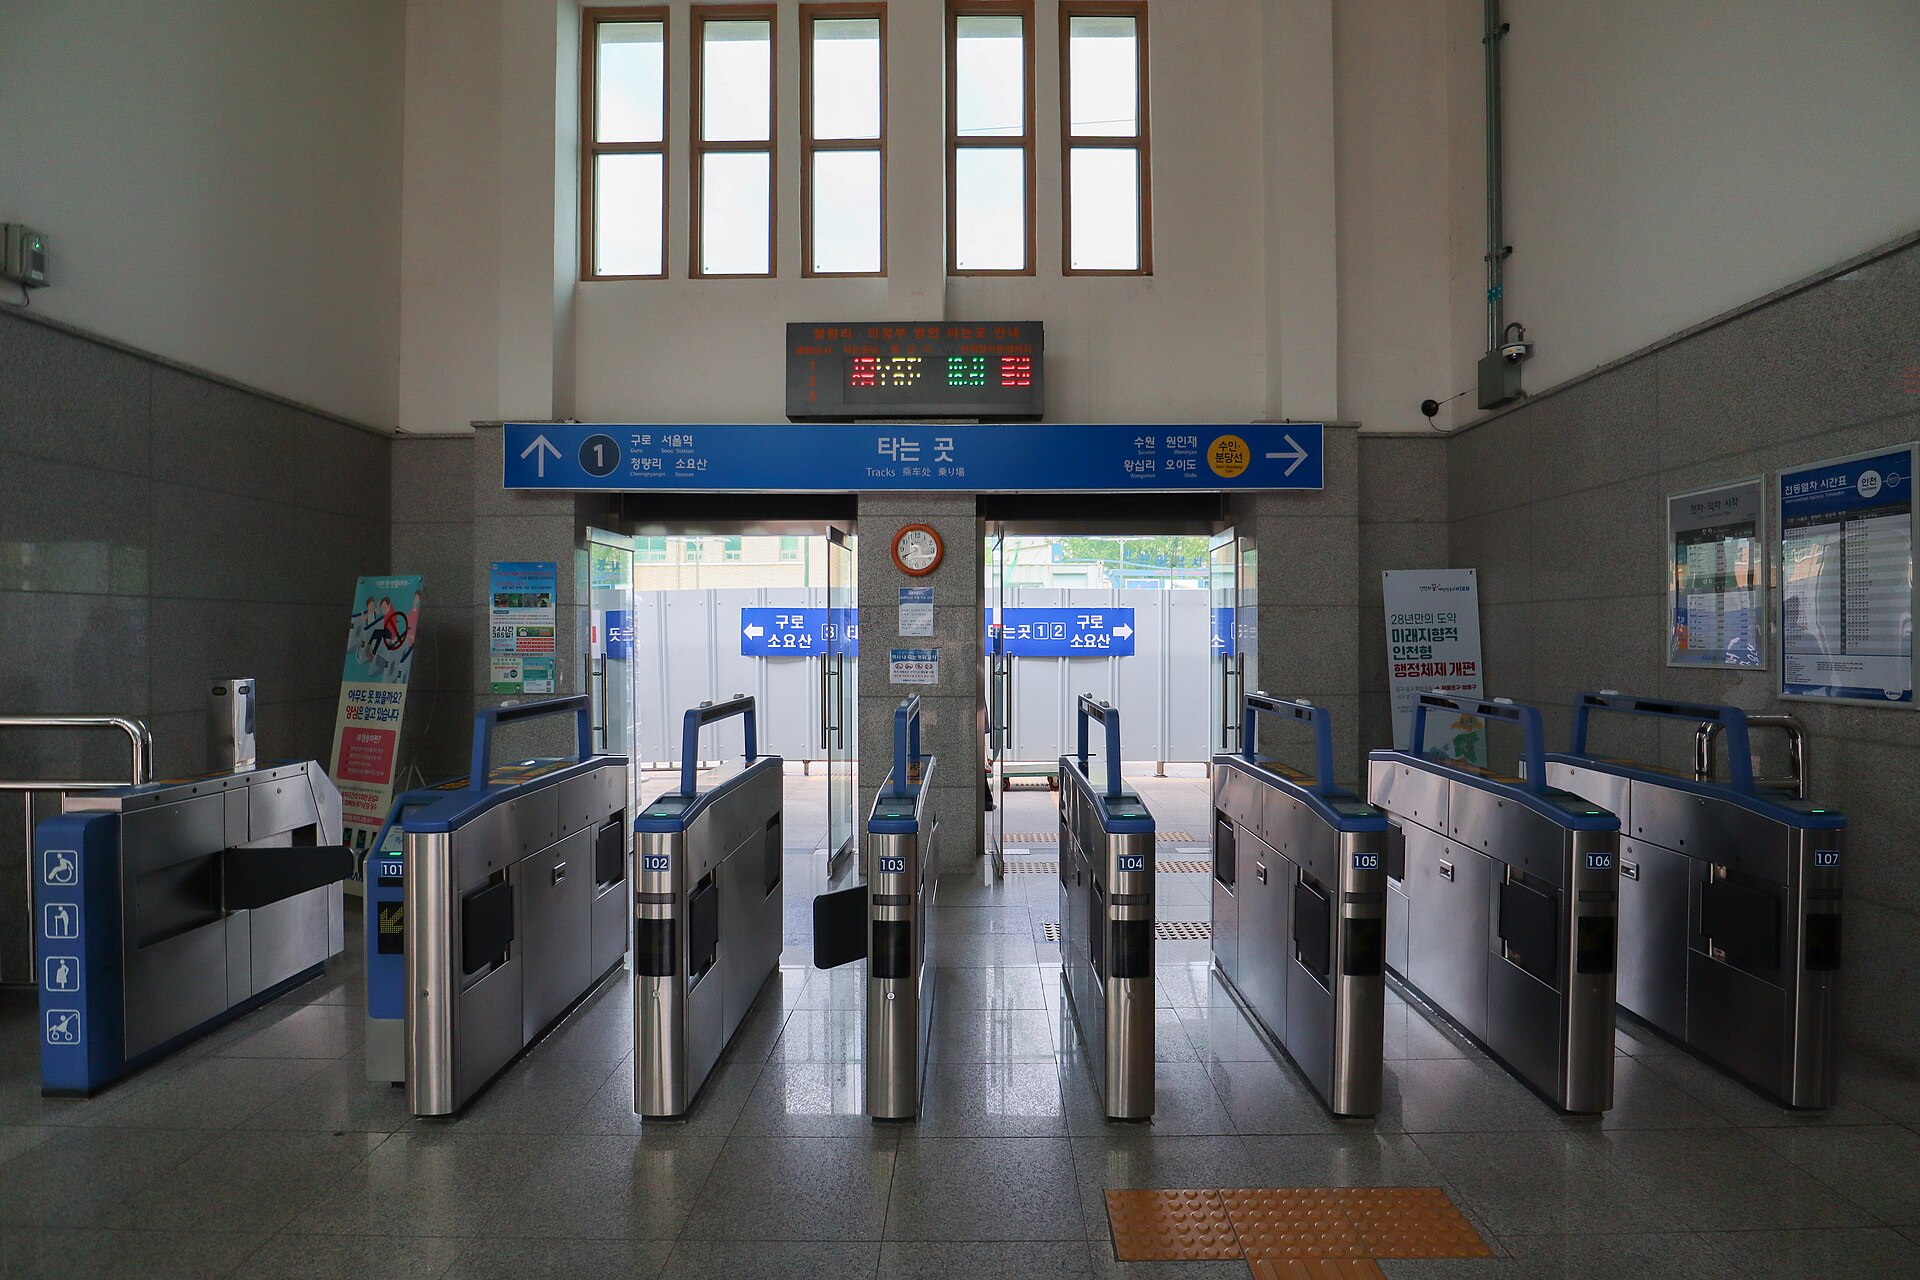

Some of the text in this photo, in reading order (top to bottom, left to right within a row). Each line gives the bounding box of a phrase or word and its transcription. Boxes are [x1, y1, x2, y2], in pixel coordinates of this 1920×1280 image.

[631, 434, 693, 448] 구로 서울역
[1134, 435, 1197, 449] 수원 원인재
[593, 443, 604, 467] 1
[877, 436, 955, 463] 타는 곳
[630, 457, 708, 471] 청량리 소요산
[1215, 452, 1243, 464] 분당선
[866, 466, 896, 477] Tracks
[1123, 459, 1197, 472] 왕십리 오이도
[1785, 475, 1847, 496] 전동열차 시간표
[1861, 477, 1877, 487] 인천
[775, 614, 805, 630] 구로
[1076, 614, 1104, 630] 구로
[1390, 612, 1457, 625] 28년만의 도약
[1036, 625, 1046, 637] 1
[1053, 625, 1064, 637] 2
[1391, 627, 1458, 643] 미래지향적
[767, 633, 813, 649] 소요산
[1069, 633, 1111, 649] 소요산
[1393, 645, 1433, 660] 인천형
[1394, 661, 1477, 678] 행정체제 개편
[347, 689, 367, 703] 아무도
[367, 690, 374, 704] 못
[345, 705, 400, 722] 양심은 알고 있습니다
[644, 856, 669, 870] 102
[880, 858, 905, 872] 103
[1119, 856, 1143, 870] 104
[1354, 855, 1378, 868] 105
[1588, 854, 1611, 867] 106
[1816, 852, 1839, 865] 107
[383, 864, 403, 875] 101
